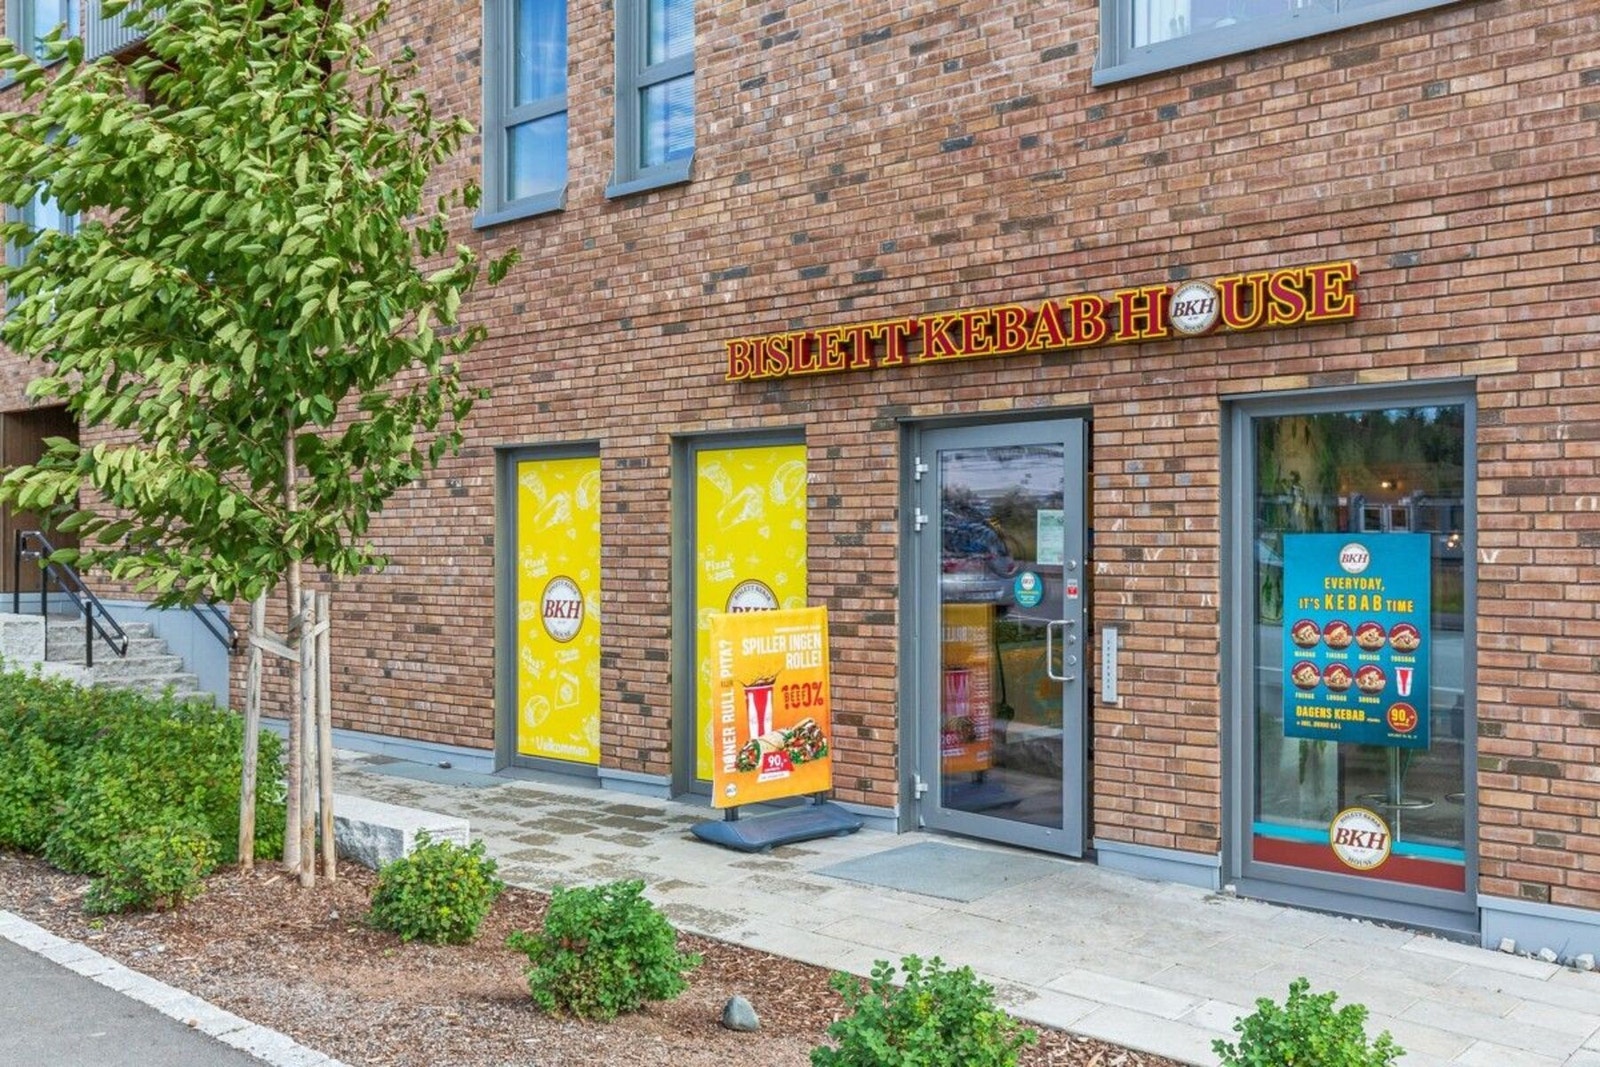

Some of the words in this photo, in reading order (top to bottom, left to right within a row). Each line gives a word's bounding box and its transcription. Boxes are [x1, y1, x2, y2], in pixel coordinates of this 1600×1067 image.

[1172, 297, 1216, 318] BKH
[725, 319, 913, 381] BISLETT
[920, 295, 1110, 361] KEBAB
[1341, 553, 1369, 564] BKH
[1324, 577, 1385, 592] EVERYDAY,
[544, 599, 582, 619] BKH
[1298, 598, 1320, 610] IT'S
[1324, 593, 1382, 612] KEBAB
[1386, 600, 1414, 613] TIME
[742, 634, 787, 656] SPILLER
[788, 631, 822, 651] INGEN
[718, 639, 734, 679] PITA?
[721, 688, 736, 724] RULL
[780, 680, 825, 710] 100%
[1296, 705, 1333, 719] DAGENS
[1334, 708, 1366, 722] KEBAB
[1334, 827, 1388, 851] BKH
